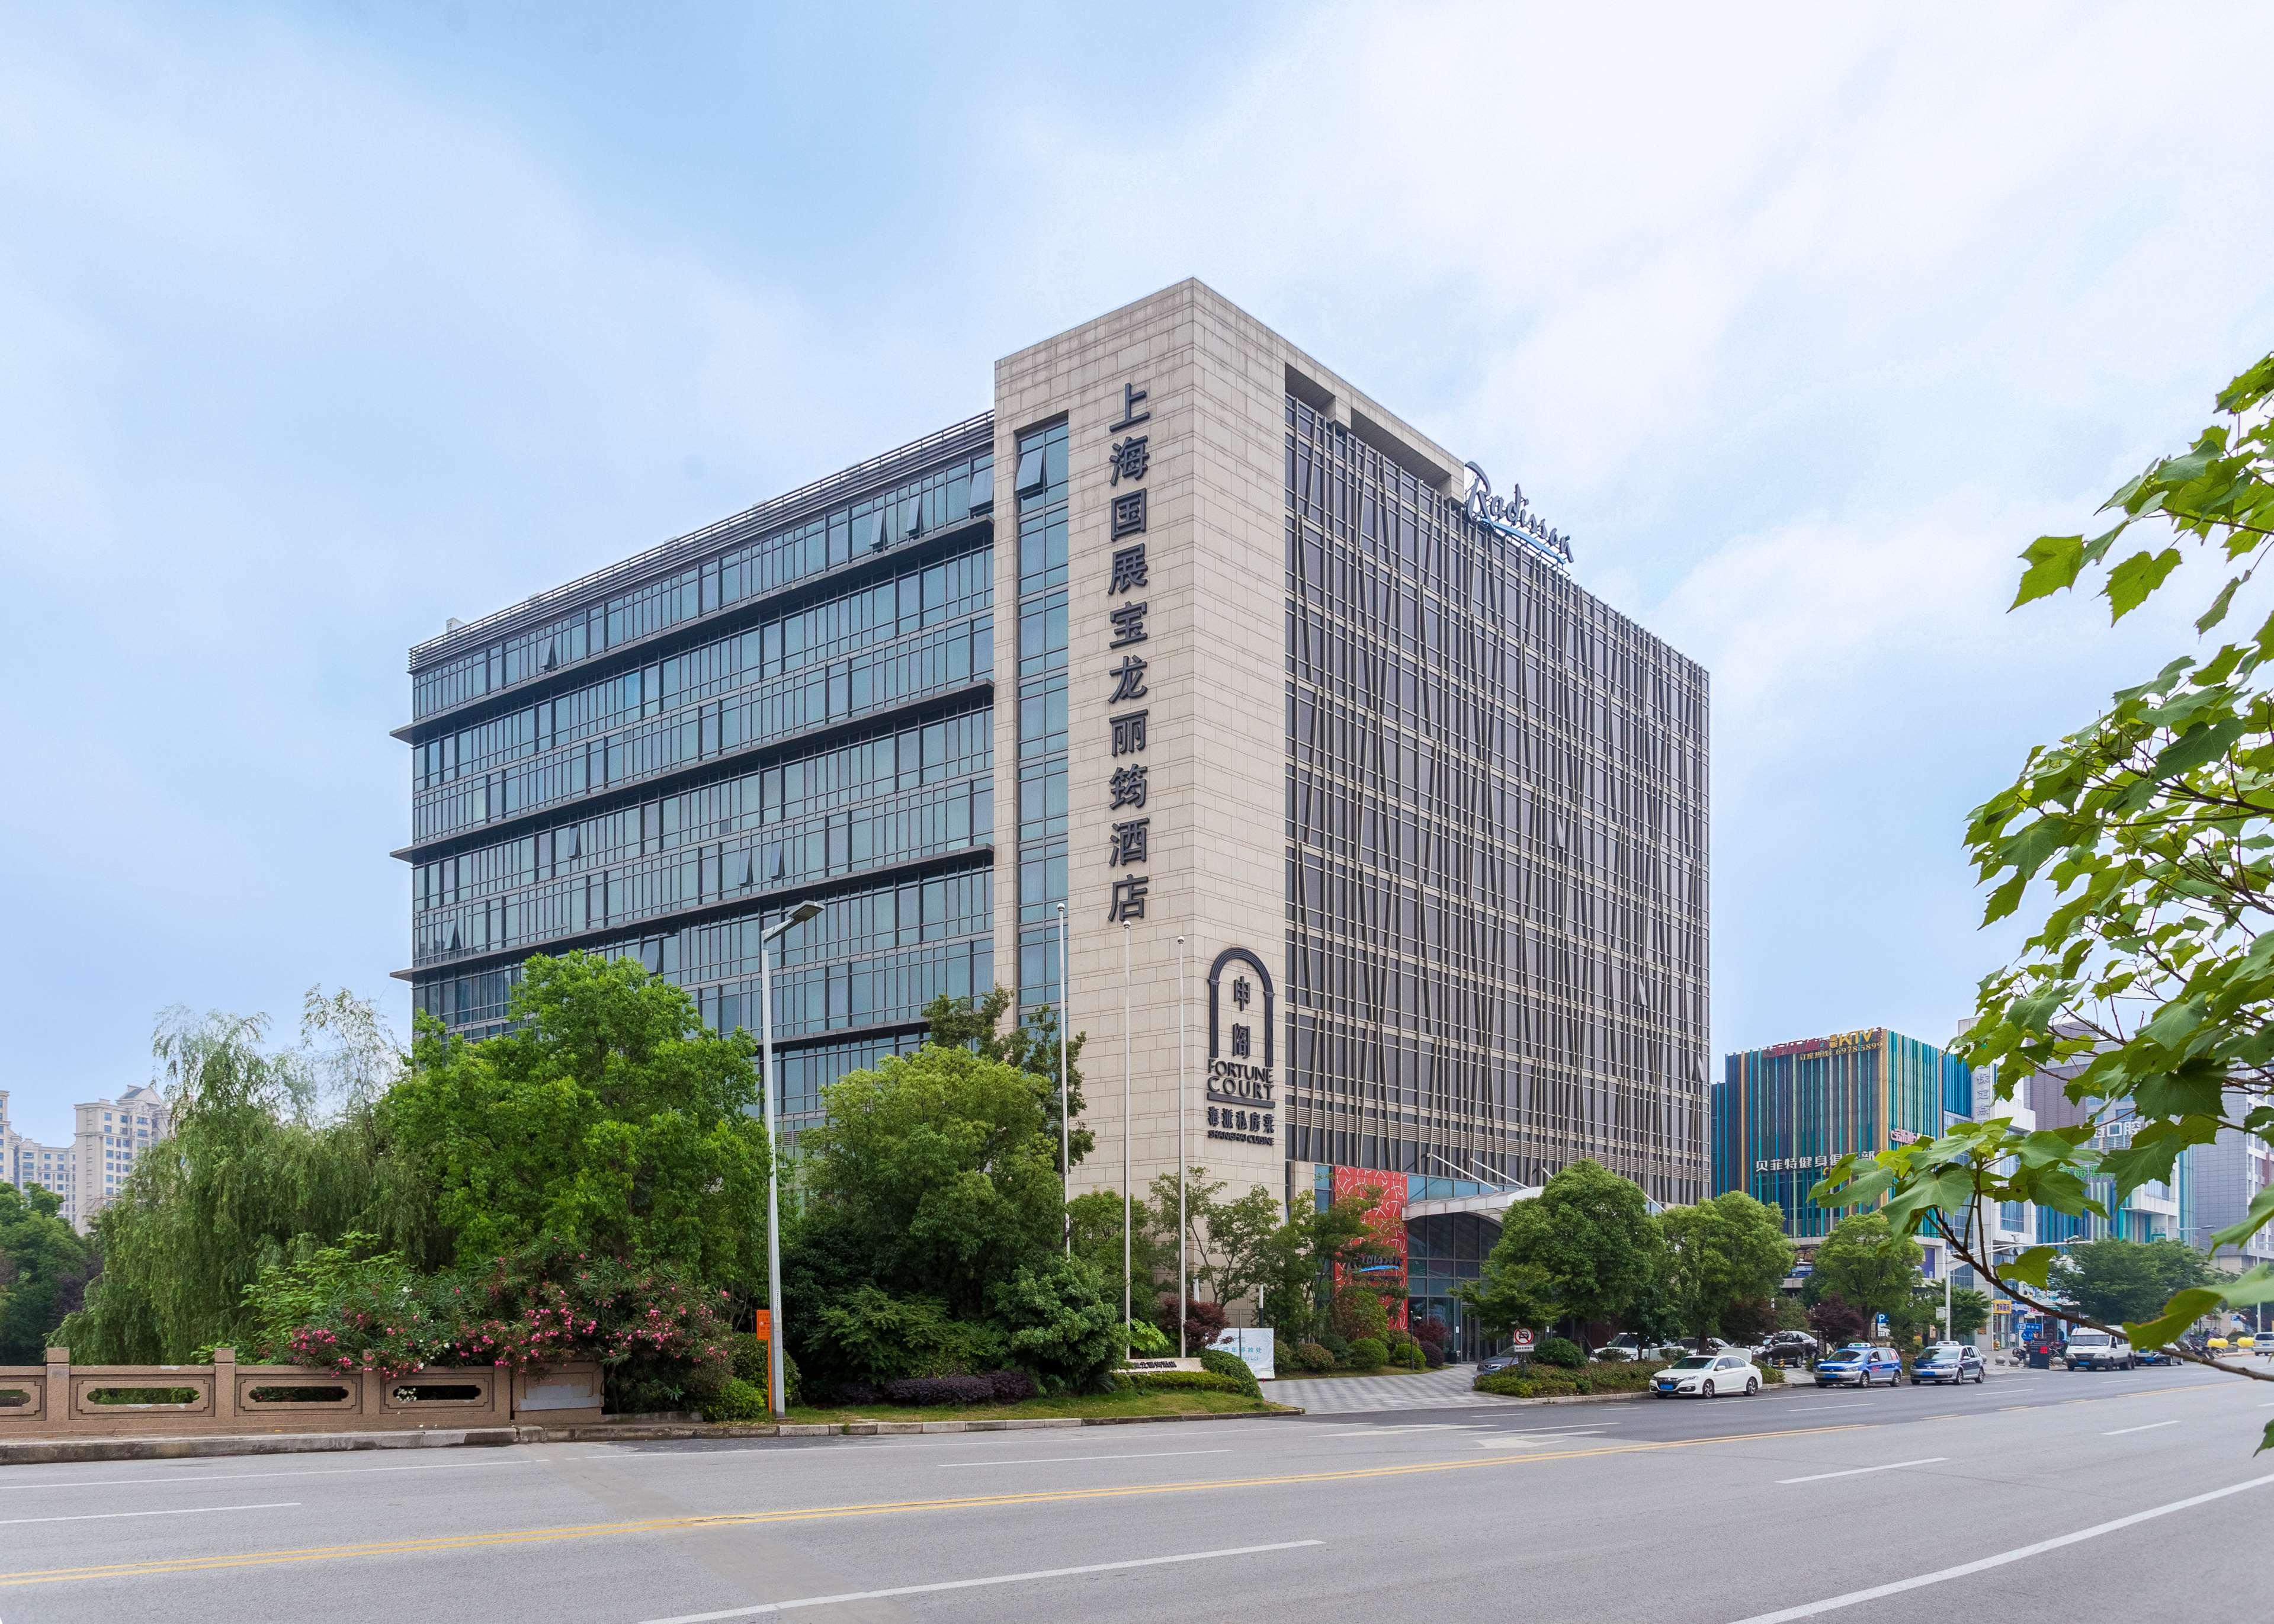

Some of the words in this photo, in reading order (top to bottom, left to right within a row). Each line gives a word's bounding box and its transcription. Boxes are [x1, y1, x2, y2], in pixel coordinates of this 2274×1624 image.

[1464, 461, 1574, 563] Radisson
[1107, 383, 1150, 922] 上海国展宝龙丽筠酒店
[1838, 1028, 1874, 1047] KTV
[1208, 1058, 1274, 1083] FORTUNE
[1208, 1076, 1275, 1100] COURT
[1207, 1106, 1275, 1134] 海派私房菜
[1208, 1130, 1246, 1142] SHANGHAI
[1246, 1135, 1275, 1146] CUISINE
[1756, 1151, 1875, 1173] 贝菲特健身俱部
